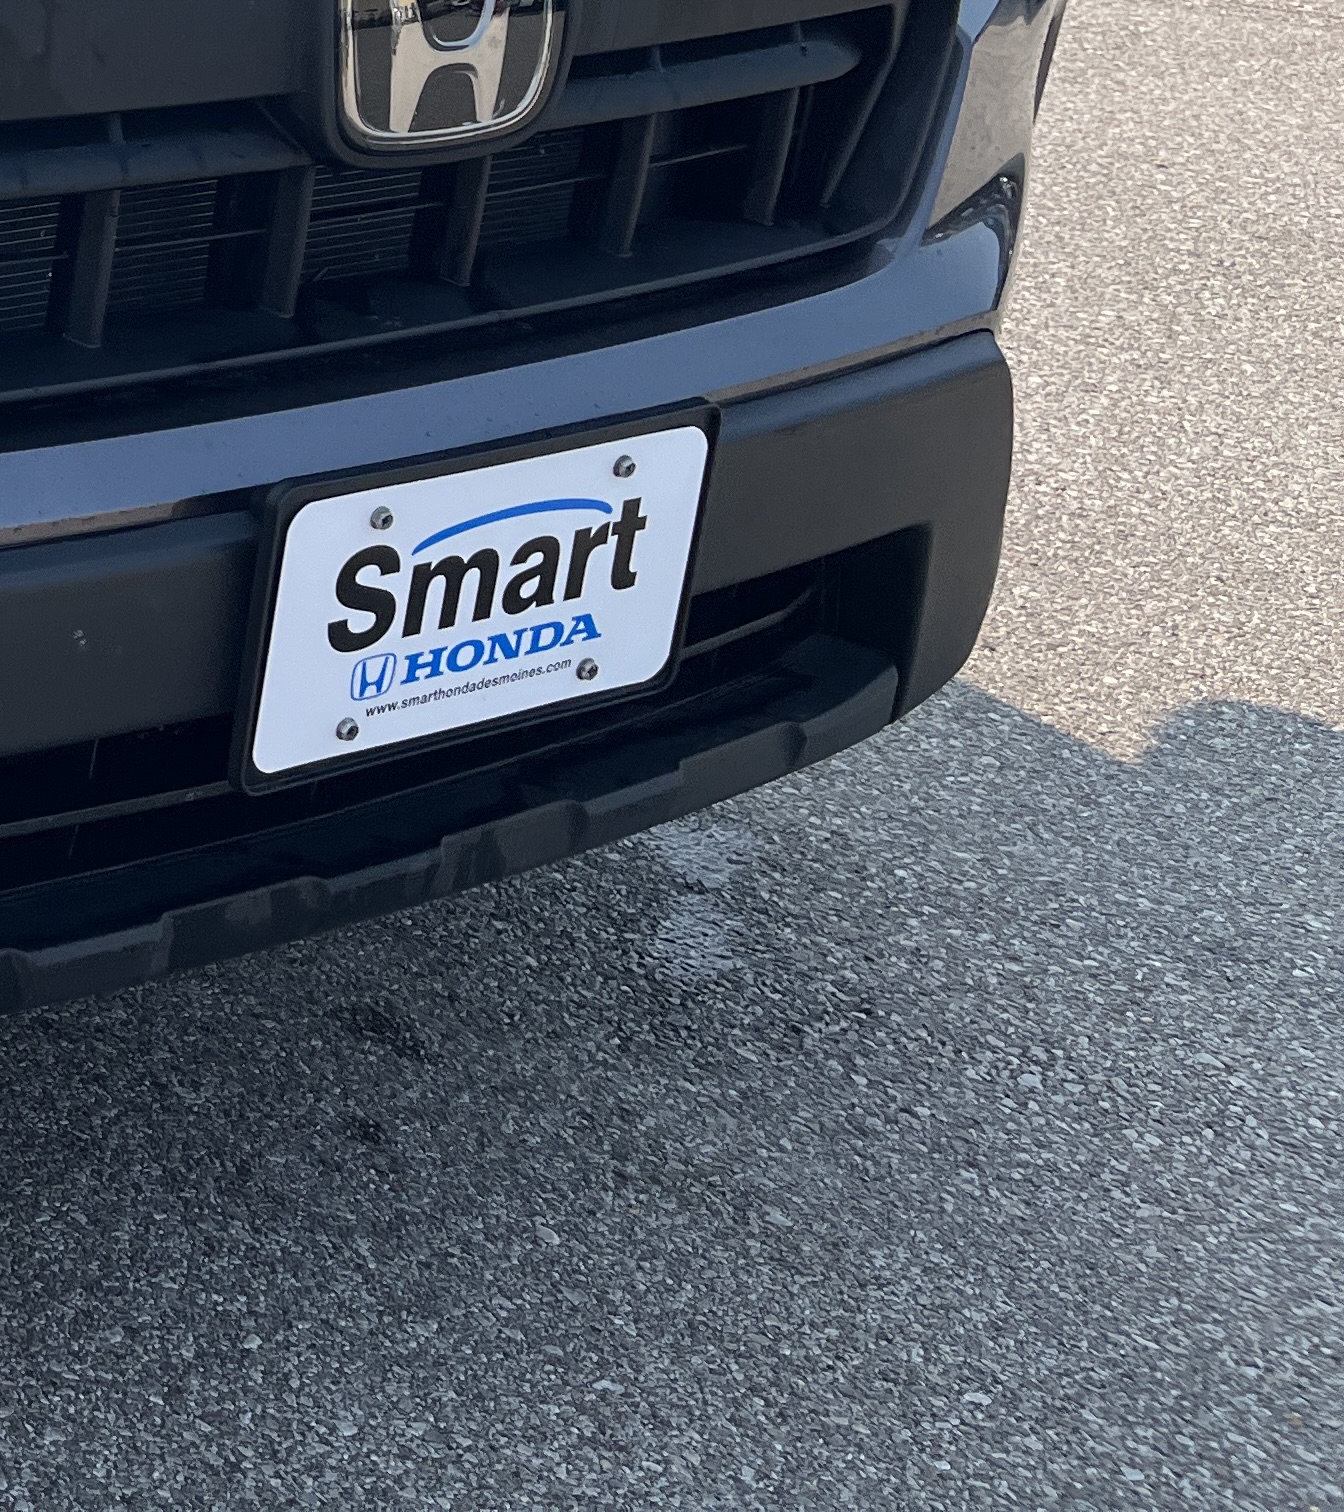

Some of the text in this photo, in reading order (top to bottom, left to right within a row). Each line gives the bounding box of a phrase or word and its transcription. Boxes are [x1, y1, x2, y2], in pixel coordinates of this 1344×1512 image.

[327, 497, 648, 652] Smart
[400, 613, 601, 685] HONDA
[365, 657, 572, 717] www.smarthondadesmoines.com
